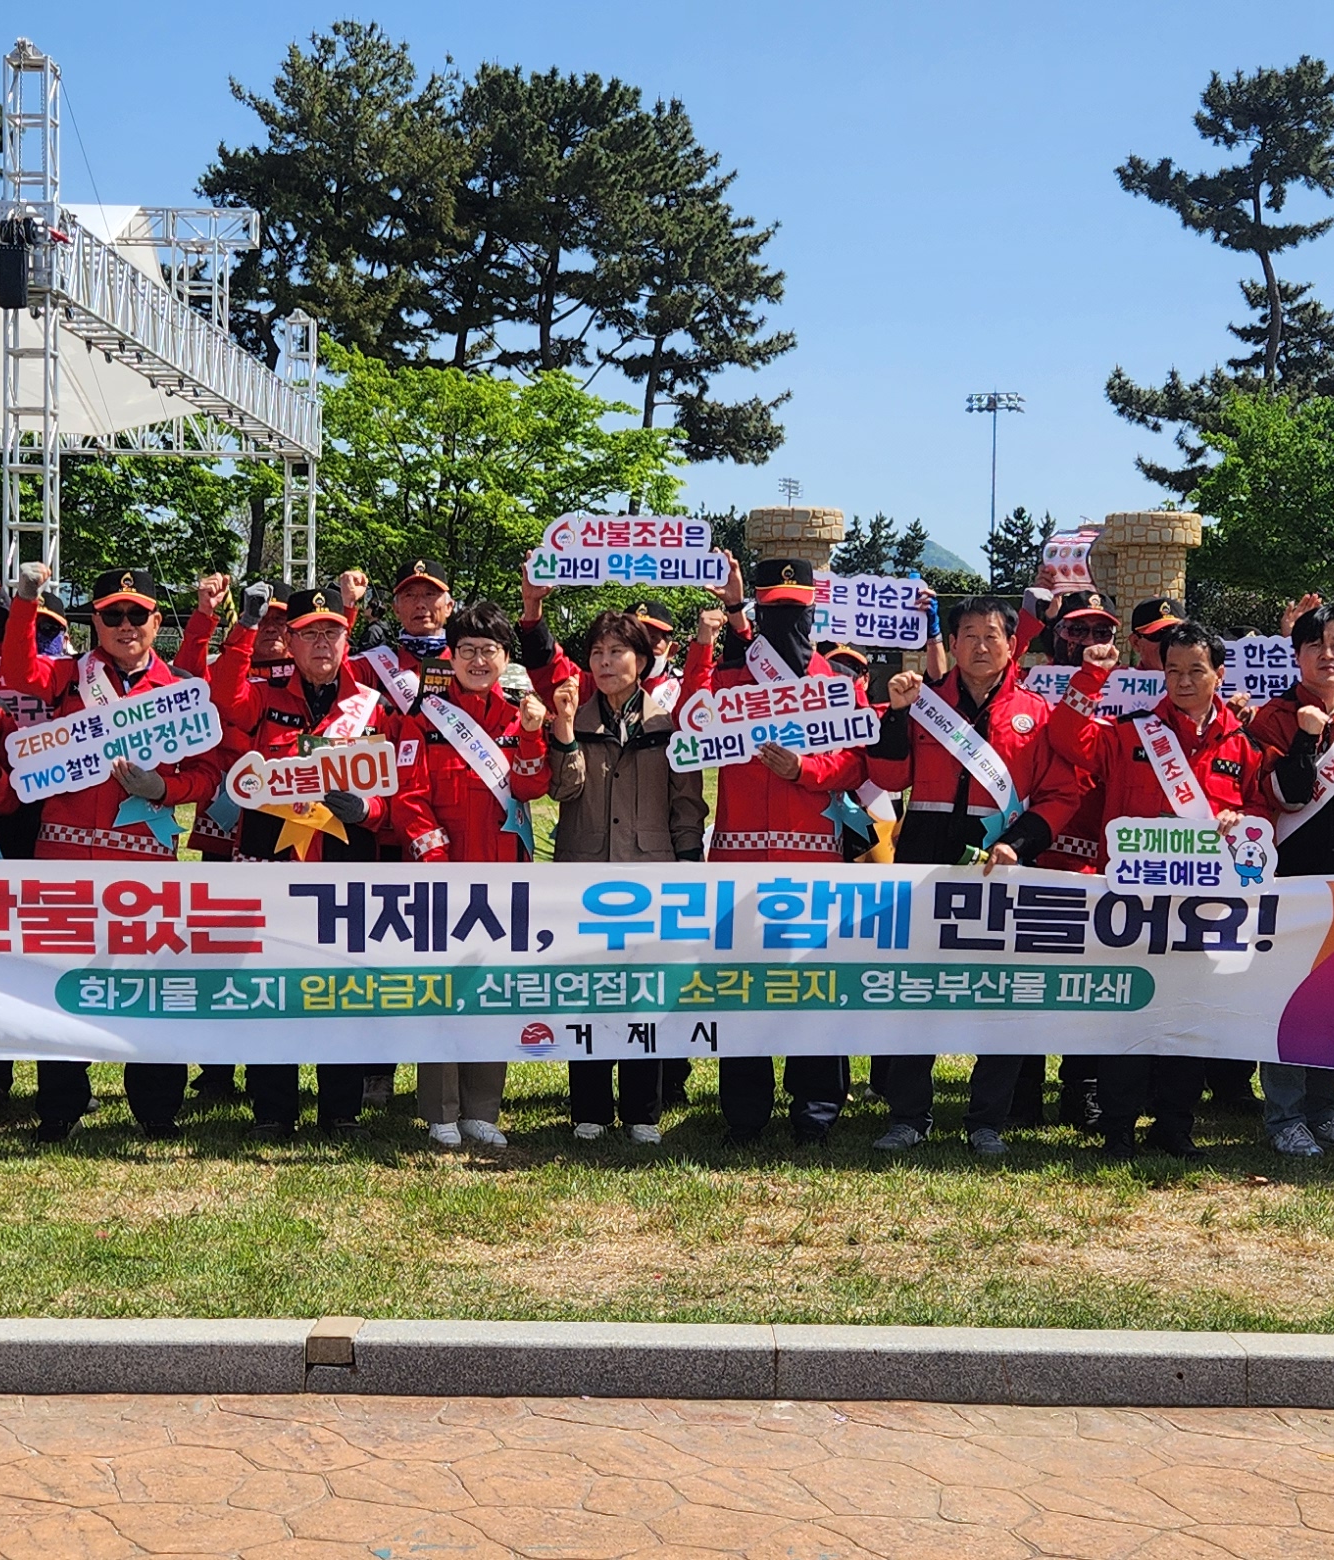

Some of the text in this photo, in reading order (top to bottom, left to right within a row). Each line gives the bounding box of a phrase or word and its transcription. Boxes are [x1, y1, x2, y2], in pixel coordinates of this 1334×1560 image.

[581, 521, 705, 548] 산불조심은
[533, 553, 724, 580] 산과의 약속입니다
[813, 579, 921, 611] 불은 한순간
[813, 609, 920, 641] 구는 한평생
[15, 687, 201, 759] ZERO산불, ONE하면?
[718, 680, 850, 723] 산불조심은
[20, 712, 212, 793] TWO철한 예방정신!
[672, 714, 875, 766] 산과의 약속입니다
[267, 751, 391, 797] 산불NO!
[1143, 719, 1196, 805] 산불조심
[1116, 827, 1222, 855] 함께해요
[1116, 859, 1223, 887] 산불예방
[288, 880, 554, 954] 거제시,
[577, 879, 735, 952] 우리
[756, 879, 912, 951] 함께
[932, 880, 1279, 955] 만들어요!
[78, 969, 1133, 1013] 화기물 소지 입산금지, 산림연접지 소각 금지, 영농부산물 파쇄
